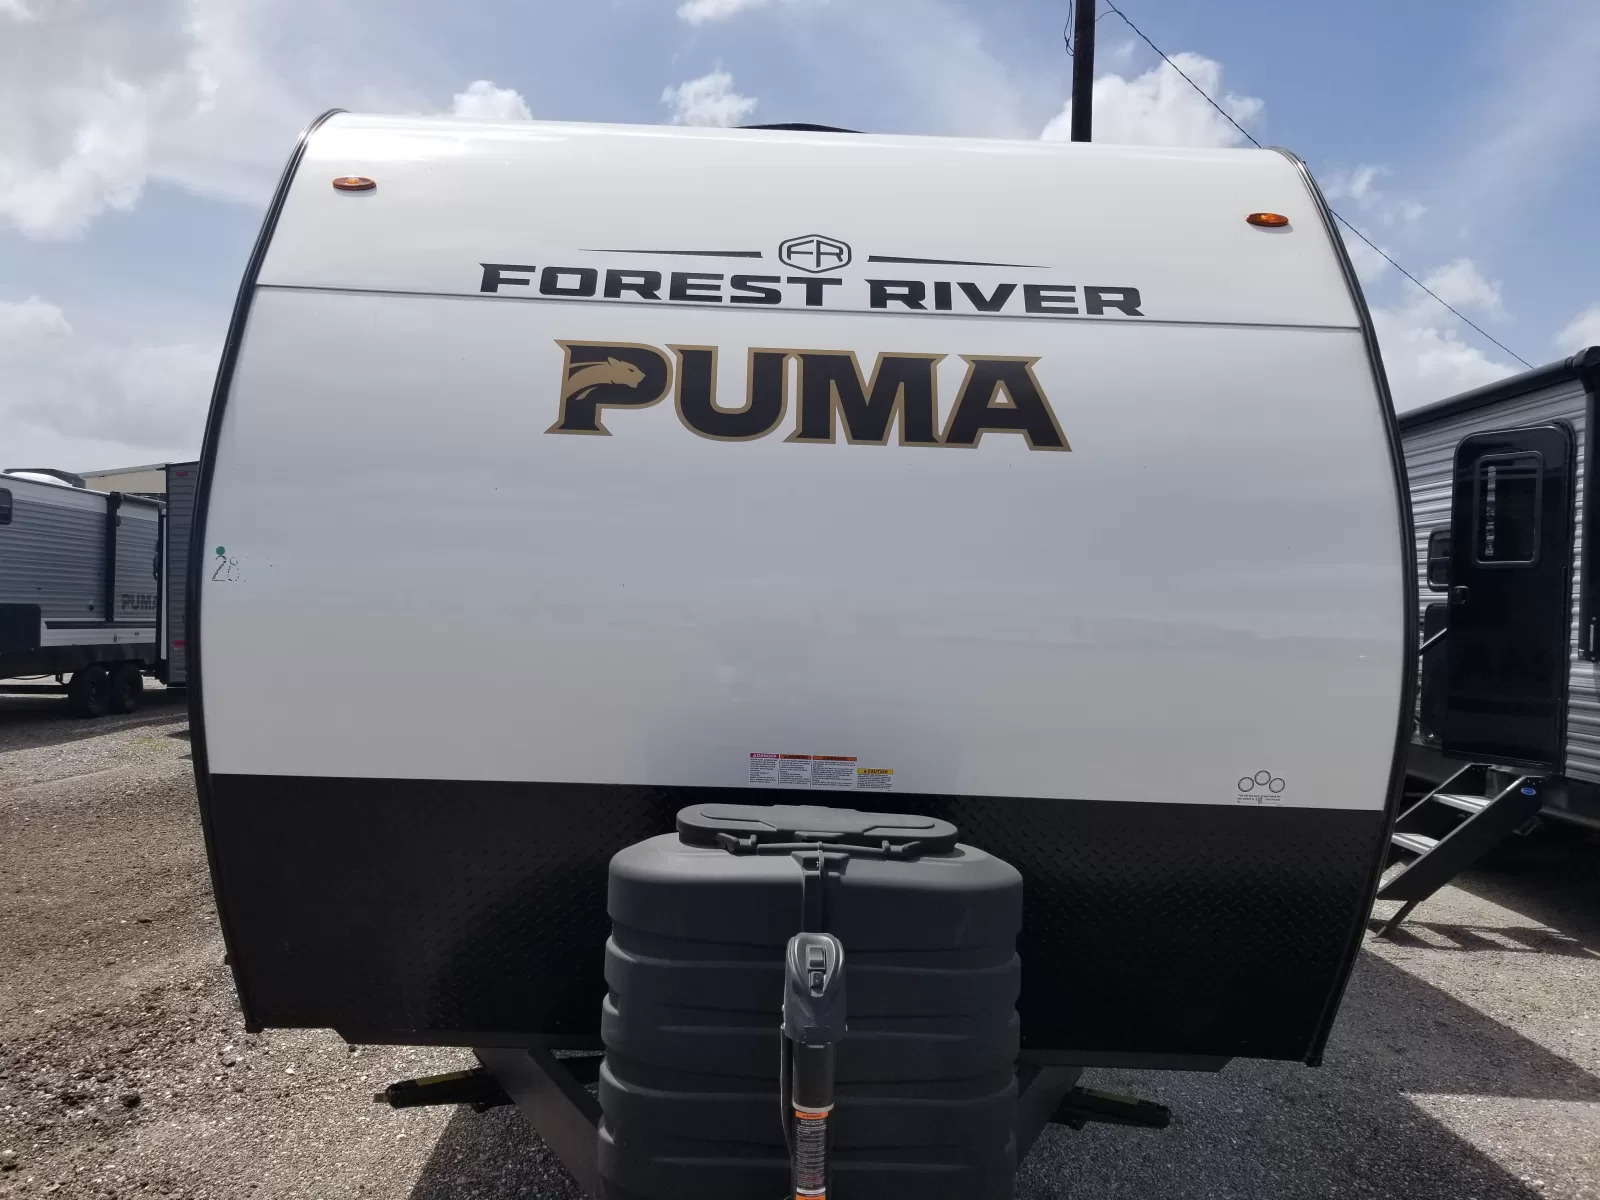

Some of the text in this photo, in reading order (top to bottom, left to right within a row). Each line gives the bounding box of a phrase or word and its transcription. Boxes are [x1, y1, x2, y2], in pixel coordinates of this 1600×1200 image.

[479, 262, 1146, 317] FOREST RIVER
[543, 339, 1073, 452] PUMA
